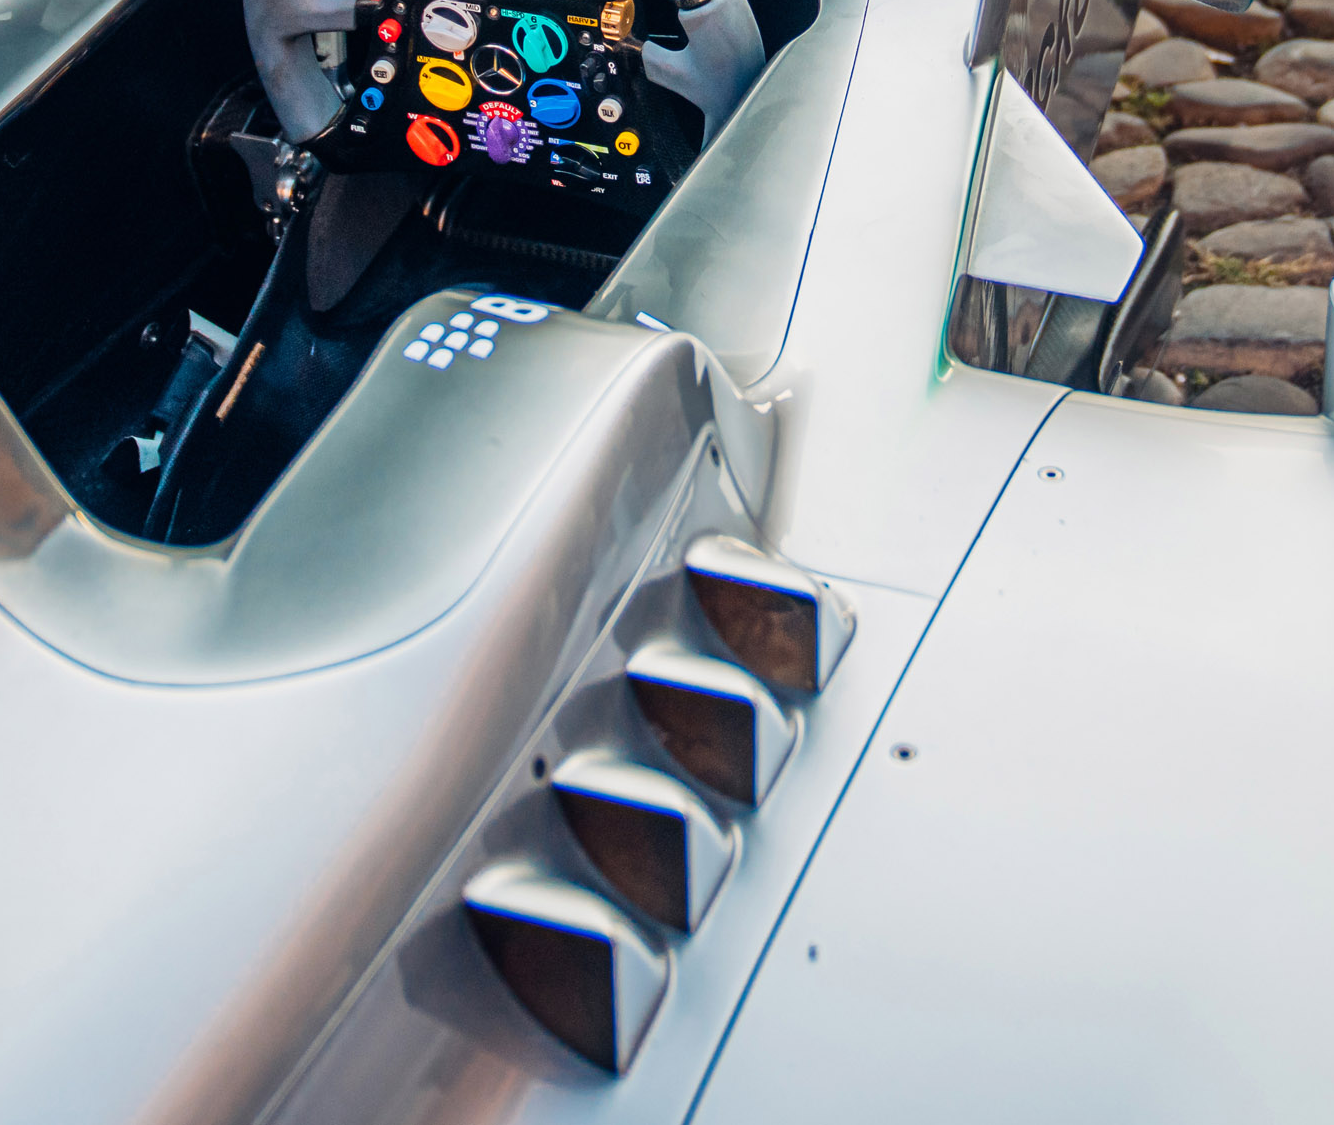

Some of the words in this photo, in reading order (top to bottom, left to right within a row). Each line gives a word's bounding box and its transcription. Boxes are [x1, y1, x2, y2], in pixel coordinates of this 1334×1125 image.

[465, 4, 480, 12] MID
[568, 16, 589, 25] HARV
[380, 28, 392, 39] X
[593, 43, 605, 52] RS
[482, 101, 521, 116] DEFAULT
[530, 100, 537, 108] 3
[601, 108, 615, 117] TALK
[350, 124, 366, 133] FUEL
[618, 142, 632, 150] OT
[602, 172, 618, 180] EXIT
